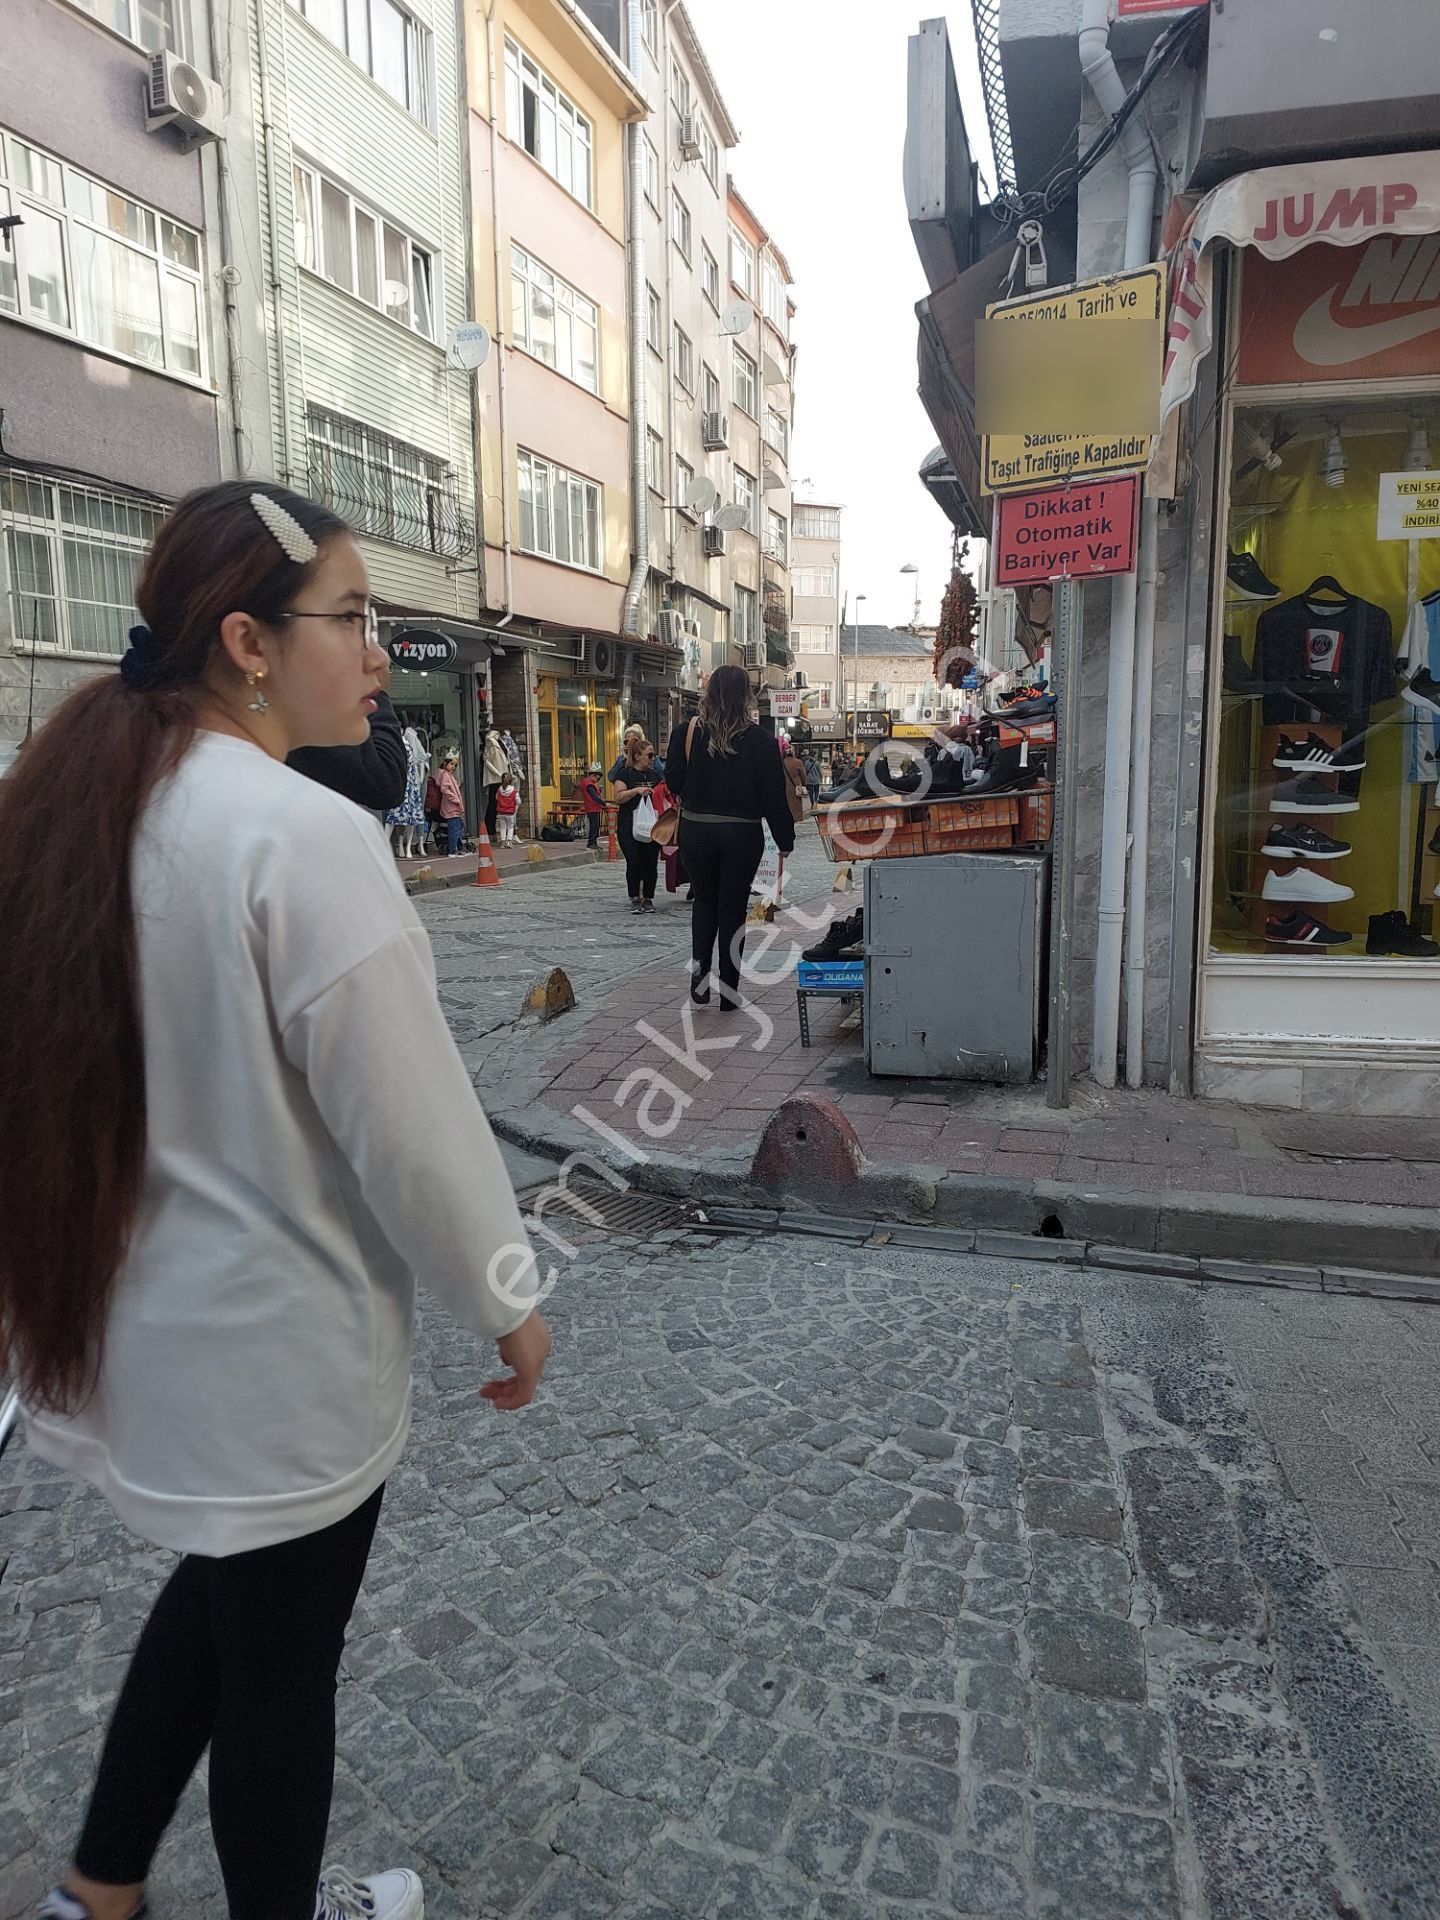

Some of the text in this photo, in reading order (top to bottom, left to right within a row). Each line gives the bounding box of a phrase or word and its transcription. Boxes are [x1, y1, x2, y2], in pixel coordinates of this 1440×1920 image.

[1253, 183, 1418, 241] JUMP
[1077, 292, 1114, 319] Tarih
[1119, 291, 1137, 309] ve
[991, 436, 1146, 482] Taşıt Trafiğine Kapalıdır
[1397, 481, 1422, 492] YENİ
[1024, 491, 1105, 519] Dikkat !
[1416, 498, 1439, 508] %40
[1016, 517, 1112, 544] Otomatik
[1005, 542, 1122, 570] Bariyer Var
[392, 639, 448, 661] vizyon
[775, 694, 797, 703] BERBER
[778, 705, 792, 714] OZAN
